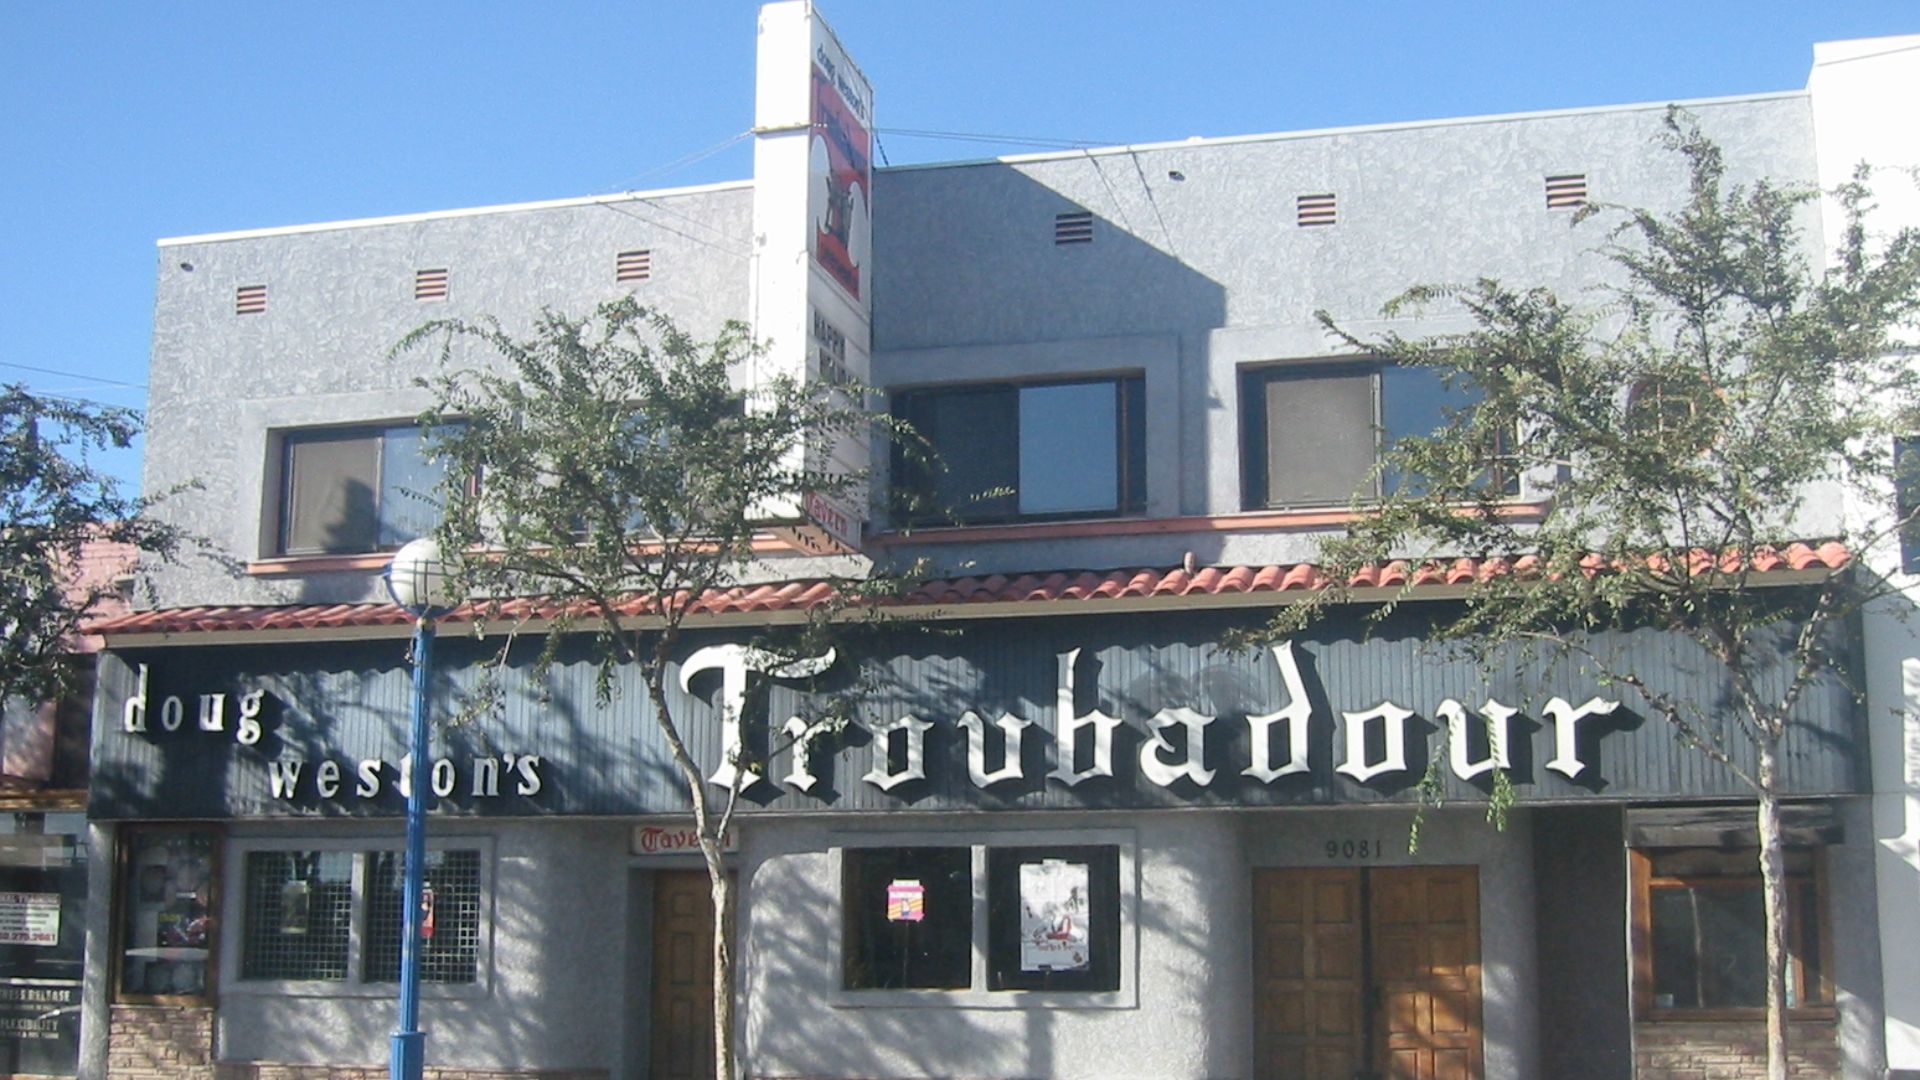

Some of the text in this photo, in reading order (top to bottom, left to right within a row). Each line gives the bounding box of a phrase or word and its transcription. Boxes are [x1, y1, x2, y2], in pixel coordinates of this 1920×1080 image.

[125, 664, 265, 746] doug
[680, 640, 1621, 792] Troubadour
[641, 826, 731, 852] Tave
[1326, 840, 1381, 858] 9081
